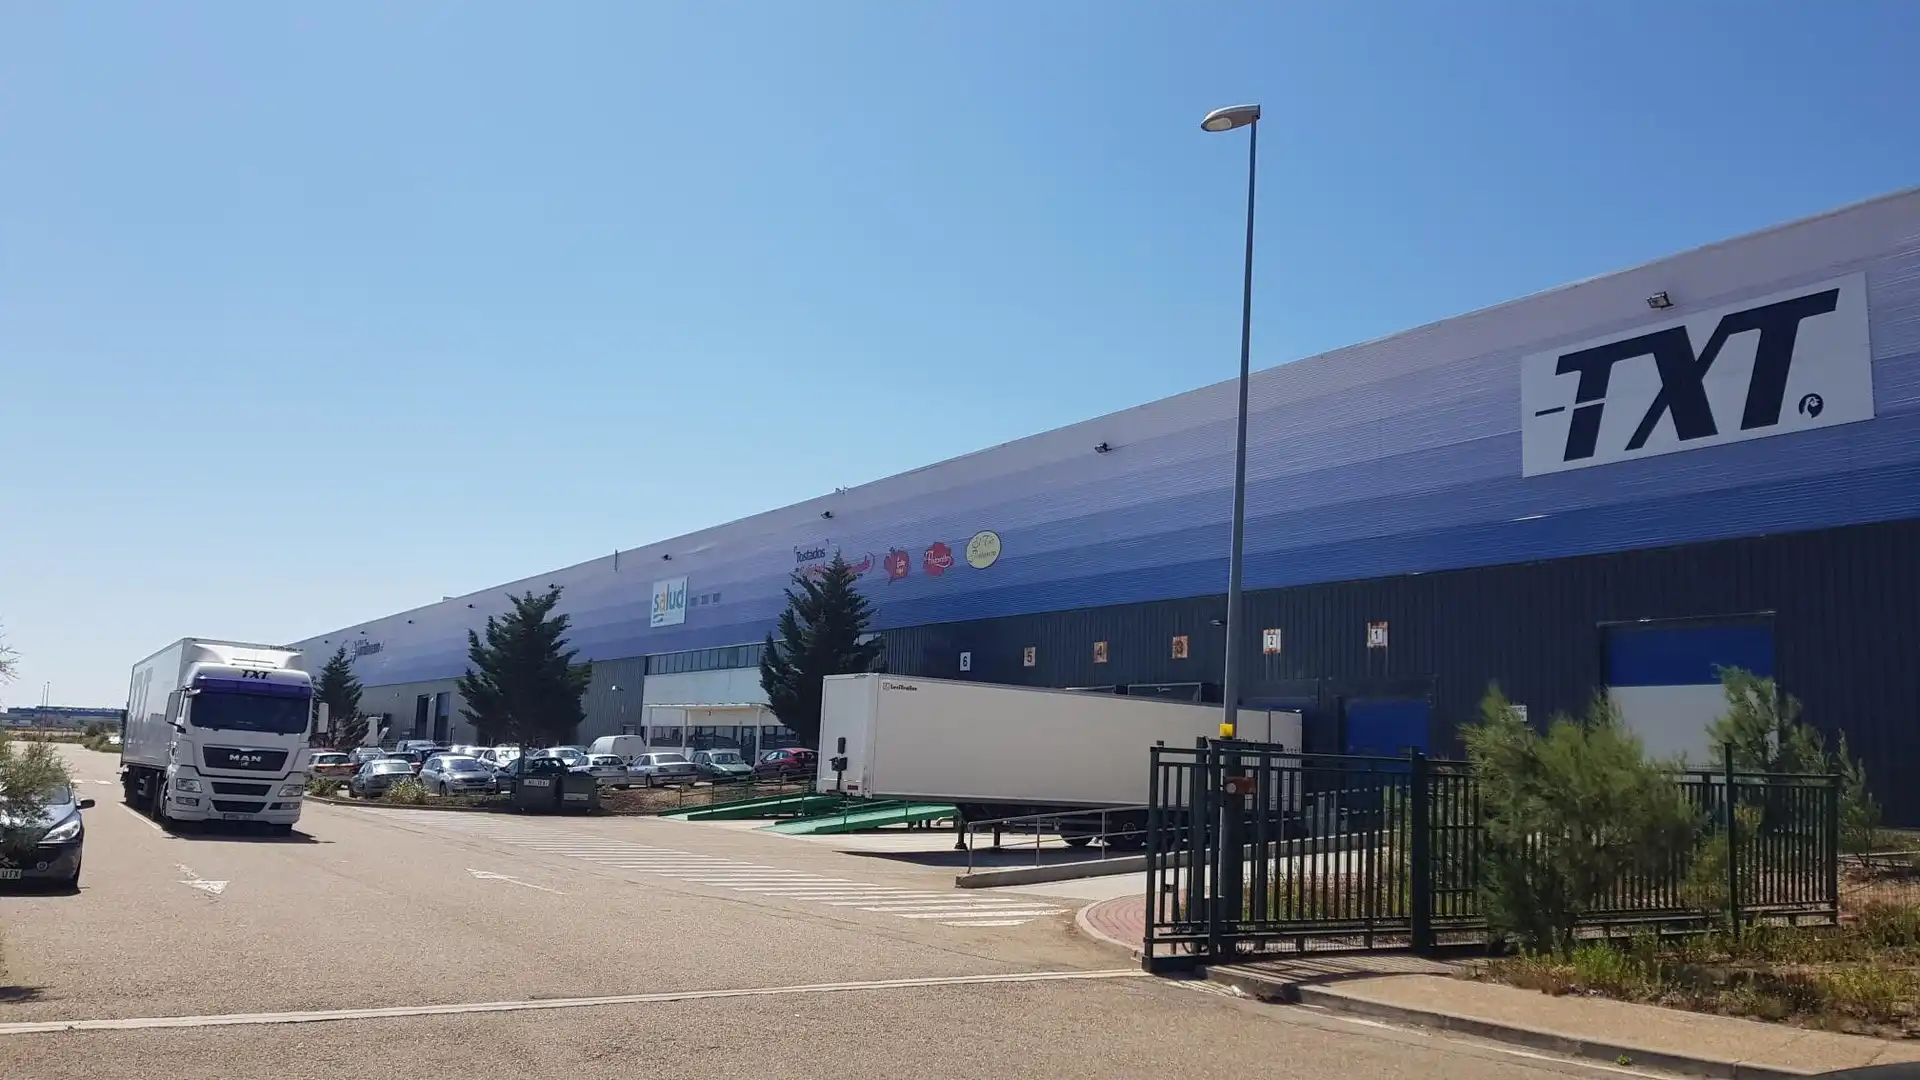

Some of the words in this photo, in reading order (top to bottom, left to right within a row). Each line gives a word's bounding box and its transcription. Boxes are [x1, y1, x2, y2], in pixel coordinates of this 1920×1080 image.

[1555, 287, 1841, 462] TXT
[653, 581, 684, 613] salud
[1175, 639, 1184, 654] 3
[962, 655, 968, 668] 6
[1026, 651, 1033, 664] 5
[242, 669, 272, 680] TXT
[229, 753, 262, 763] MAN
